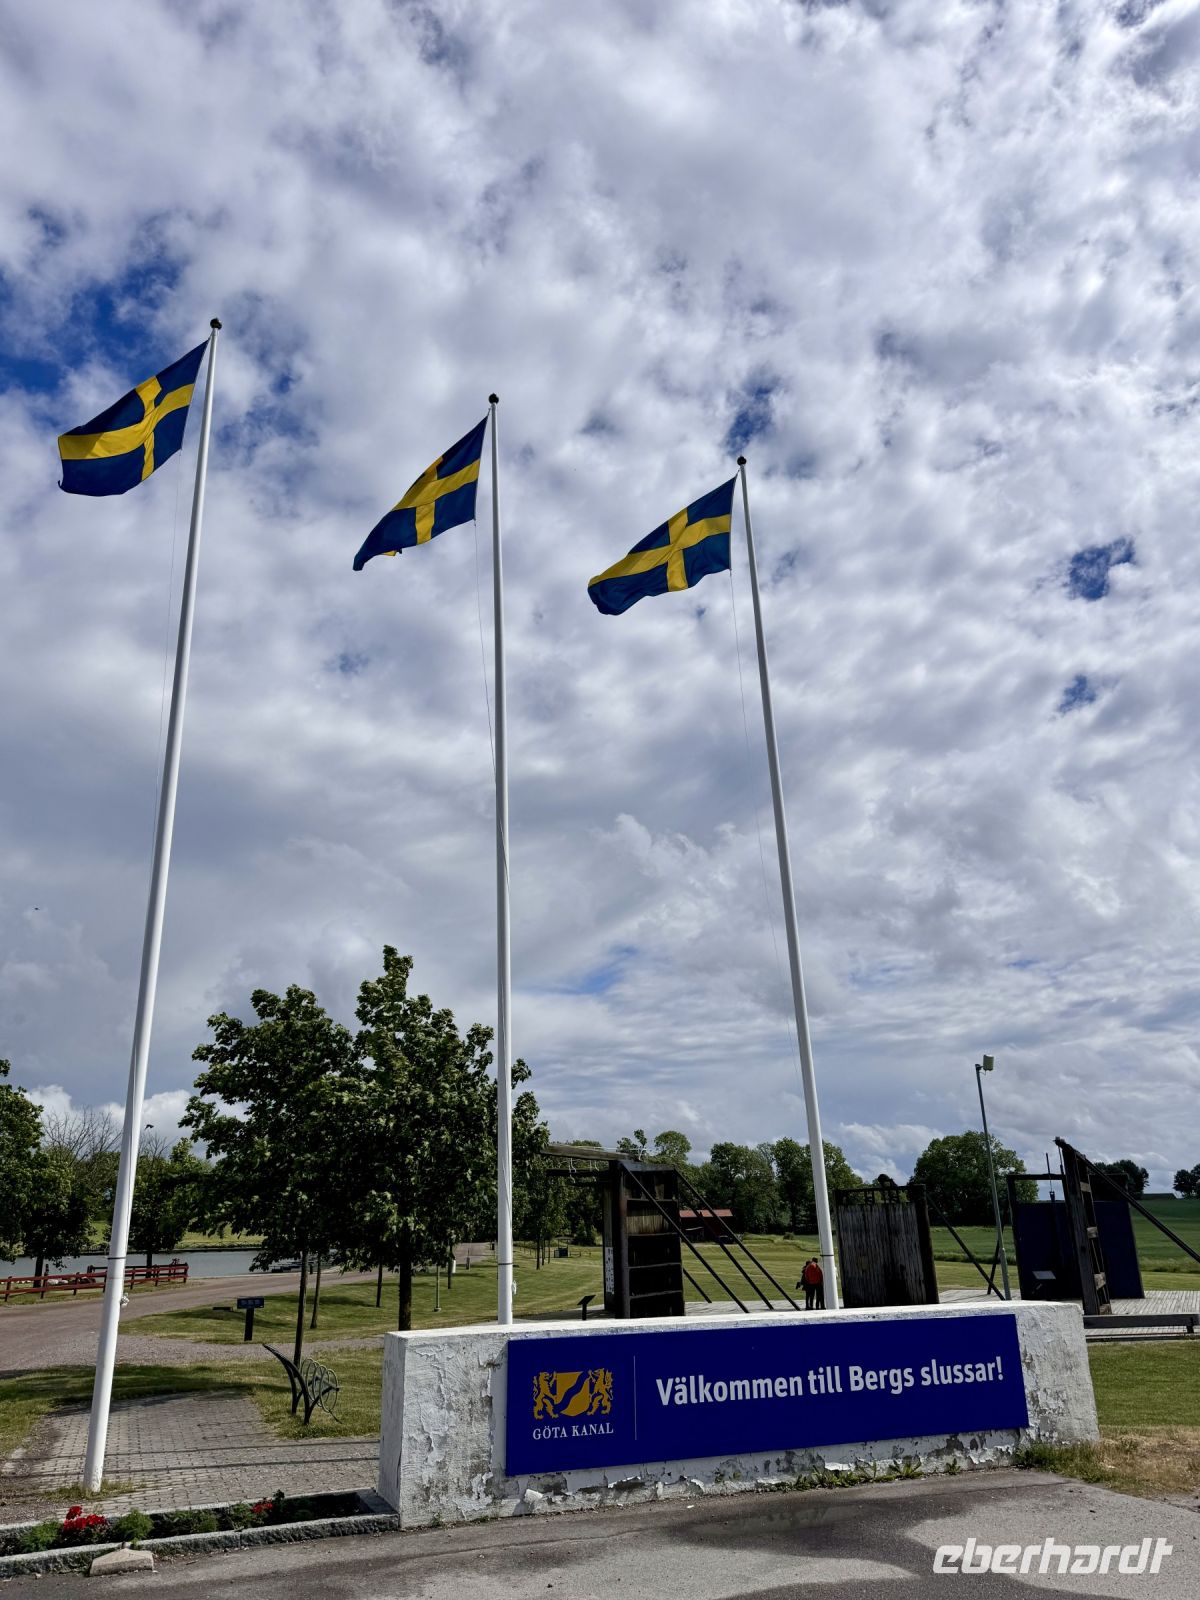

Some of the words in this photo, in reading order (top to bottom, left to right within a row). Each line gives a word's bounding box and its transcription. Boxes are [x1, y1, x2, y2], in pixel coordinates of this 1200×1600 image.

[656, 1374, 803, 1406] Välkommen
[807, 1366, 843, 1395] till
[848, 1365, 915, 1395] Bergs
[920, 1355, 1004, 1386] slussar!
[532, 1425, 568, 1440] GÖTA
[571, 1422, 614, 1437] KANAL
